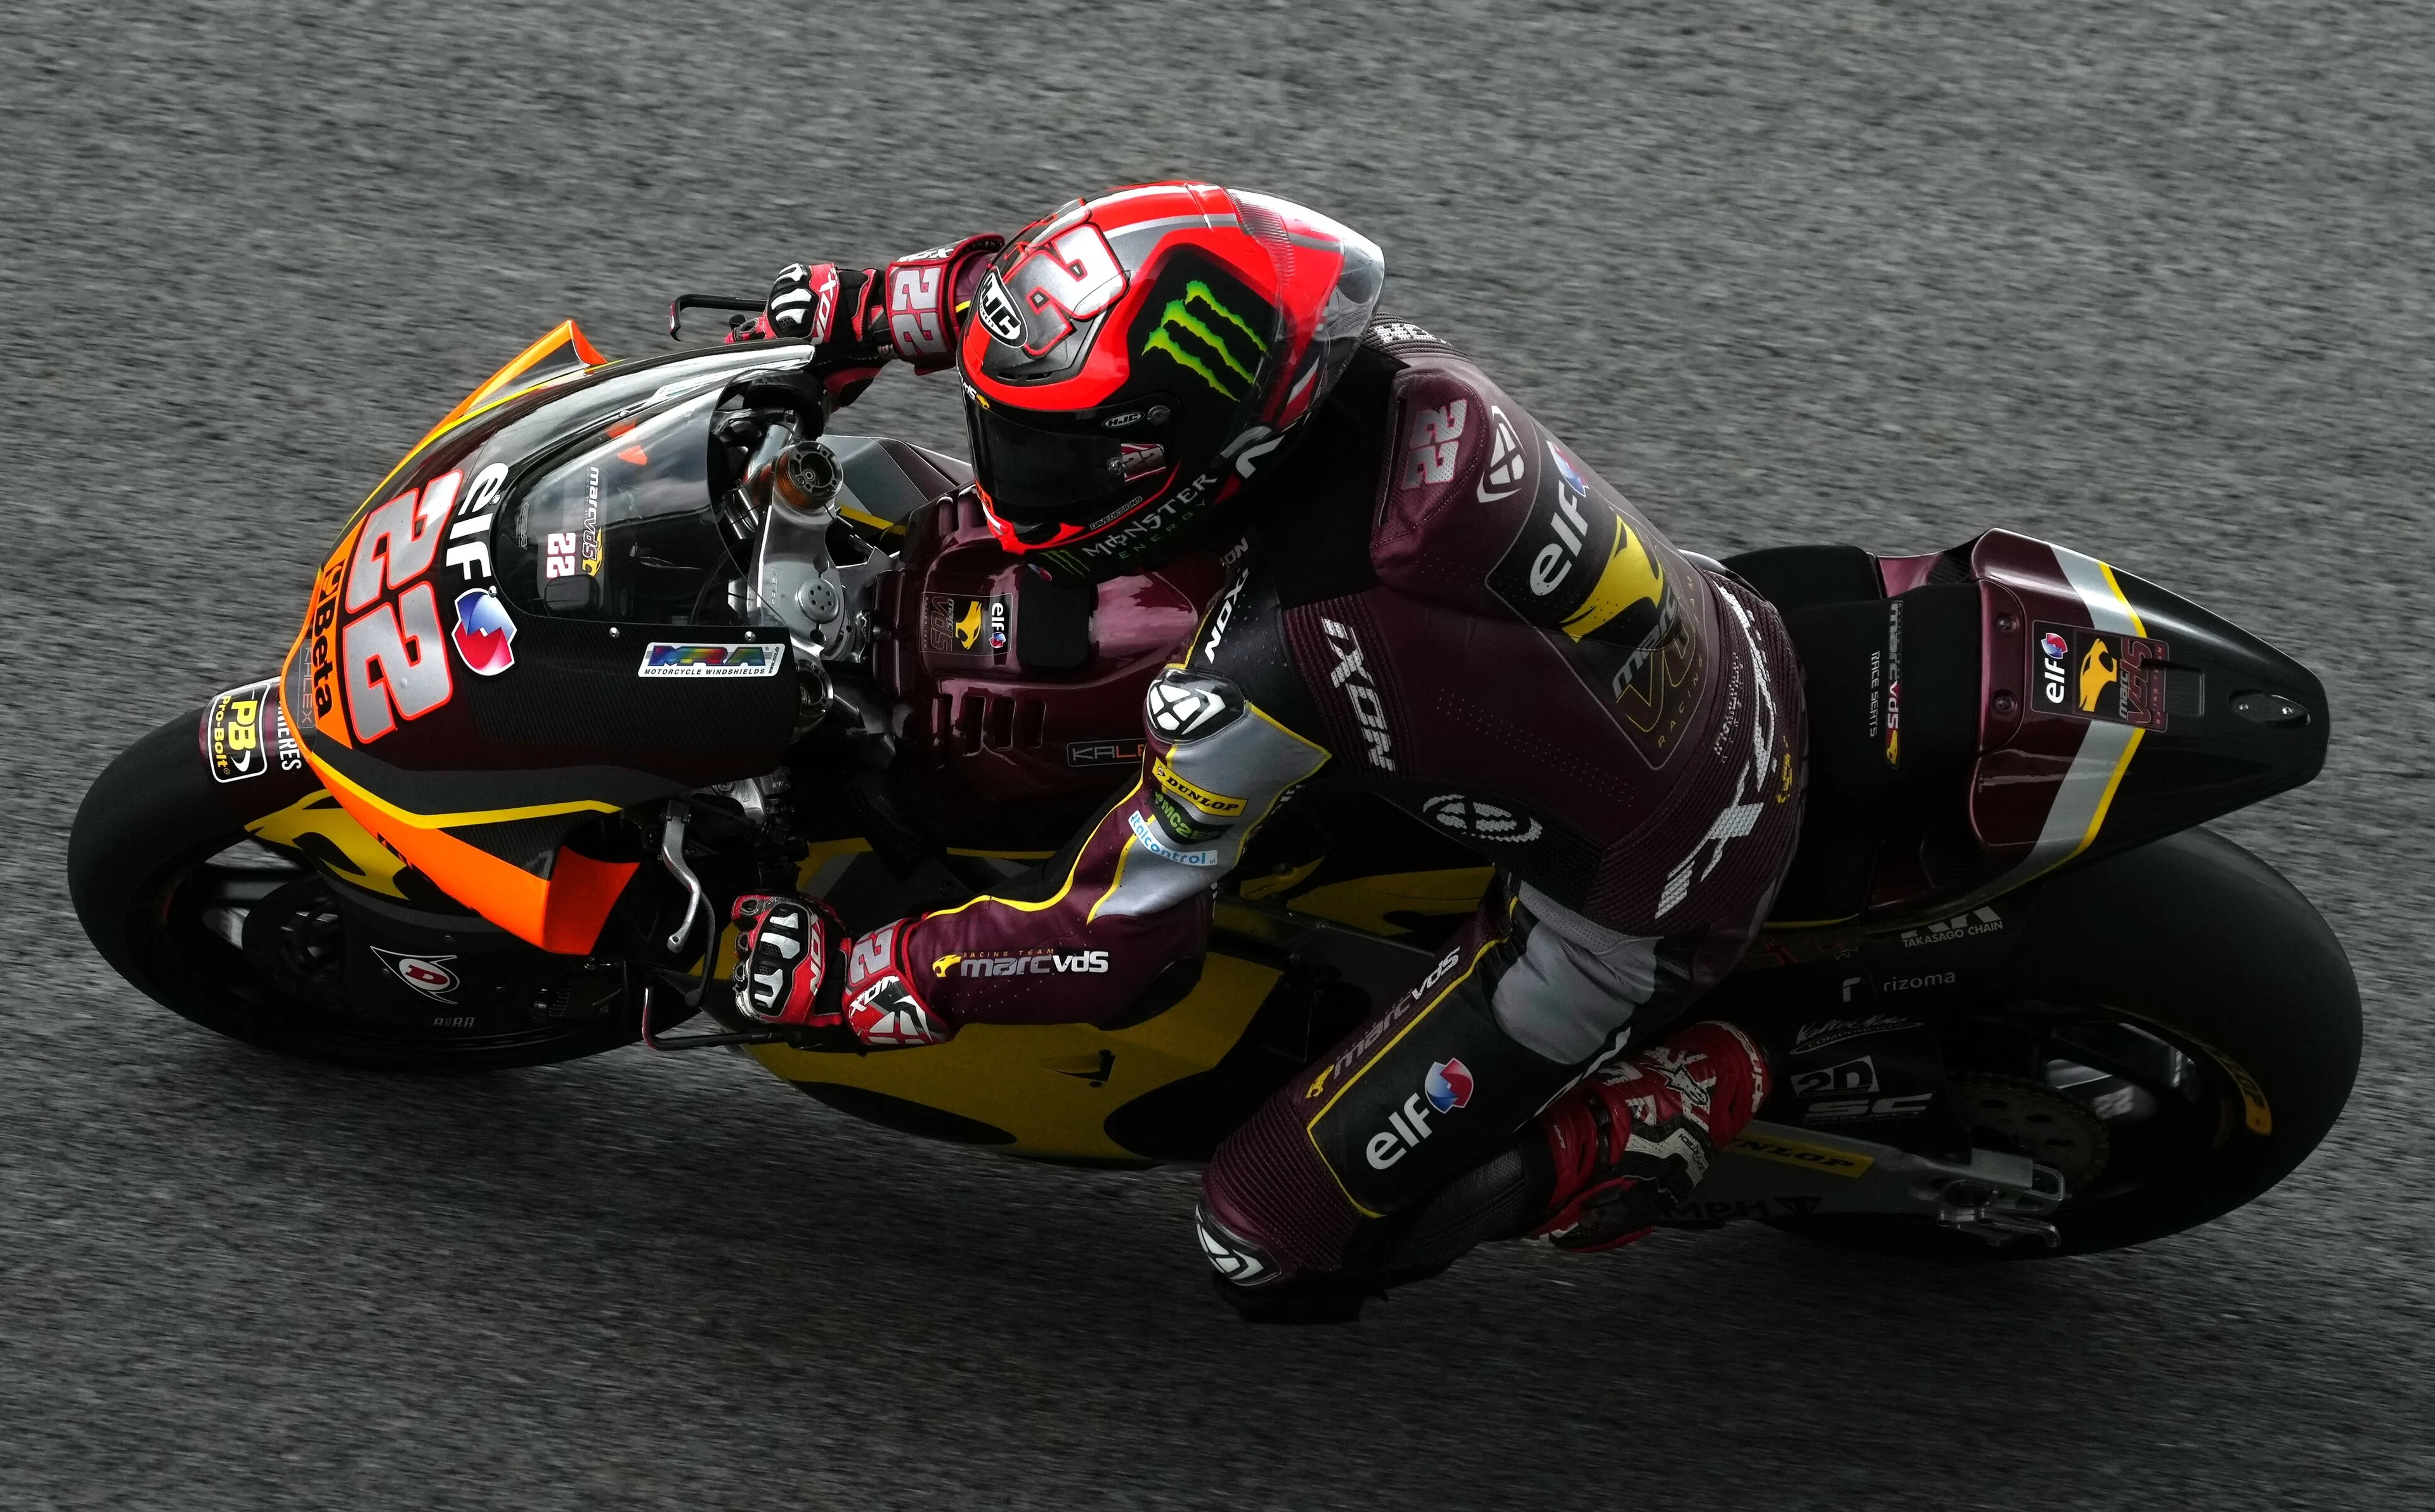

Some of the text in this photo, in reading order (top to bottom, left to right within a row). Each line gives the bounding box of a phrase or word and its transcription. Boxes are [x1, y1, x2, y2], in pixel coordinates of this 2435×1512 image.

[891, 266, 948, 356] 22
[1109, 413, 1141, 427] HJC
[1400, 397, 1468, 490] 22
[446, 462, 509, 580] elf
[1082, 474, 1218, 557] MONSTER
[1119, 500, 1205, 560] ENERGY
[1529, 480, 1589, 597] elf
[546, 532, 576, 579] 22
[343, 468, 464, 744] 22
[992, 602, 1004, 633] elf
[1205, 567, 1250, 664] IXON
[313, 596, 335, 721] Beta
[647, 645, 765, 666] MRA
[2044, 657, 2065, 704] elf
[1321, 616, 1396, 772] IXON
[228, 700, 258, 751] PB
[1072, 744, 1145, 761] KALE
[1166, 776, 1239, 811] DUNLOP
[1131, 813, 1205, 864] italcontrol
[1902, 920, 2004, 948] TAKASAGO CHAIN
[1883, 971, 1956, 993] rizoma
[1797, 1060, 1874, 1097] 2D
[1366, 1092, 1434, 1170] elf
[1731, 1138, 1857, 1168] NLOP
